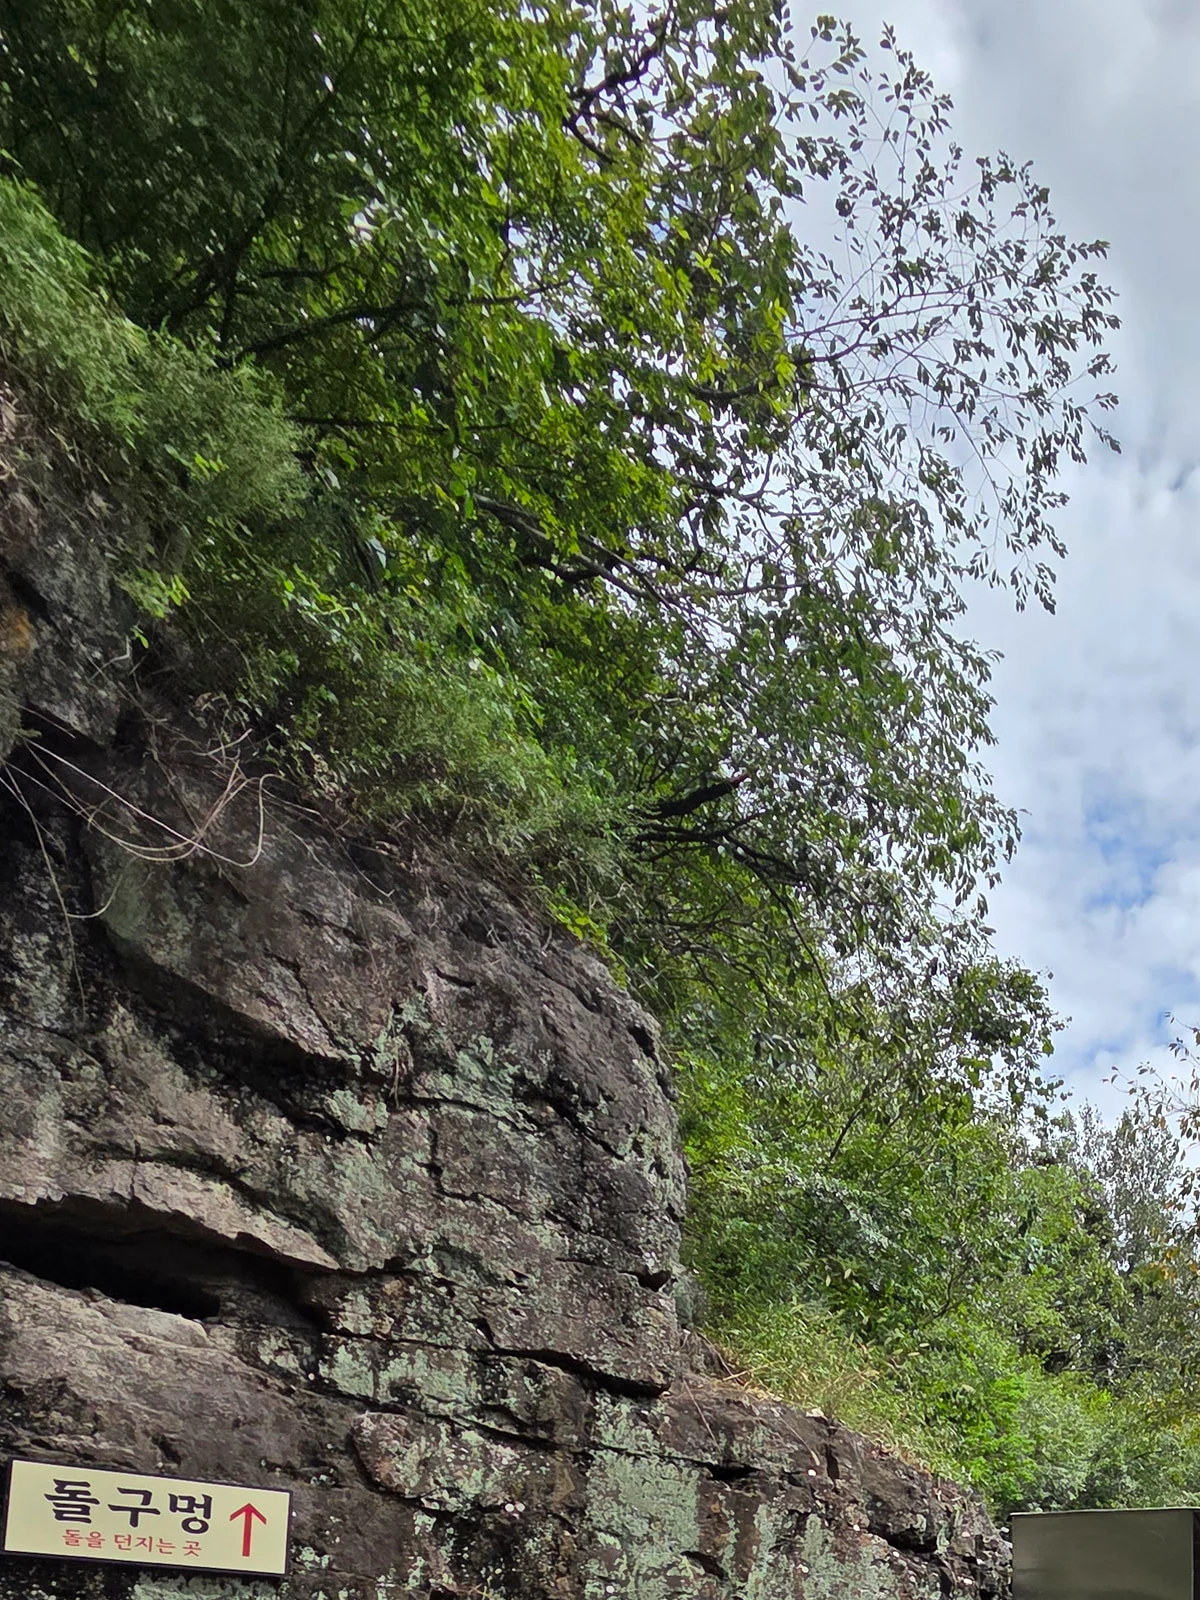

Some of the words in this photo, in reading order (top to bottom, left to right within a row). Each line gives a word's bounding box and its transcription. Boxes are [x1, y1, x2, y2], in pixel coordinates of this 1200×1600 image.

[44, 1478, 213, 1535] 돌구멍
[62, 1529, 105, 1549] 돌을
[114, 1533, 176, 1555] 던지는
[182, 1539, 202, 1557] 곳
